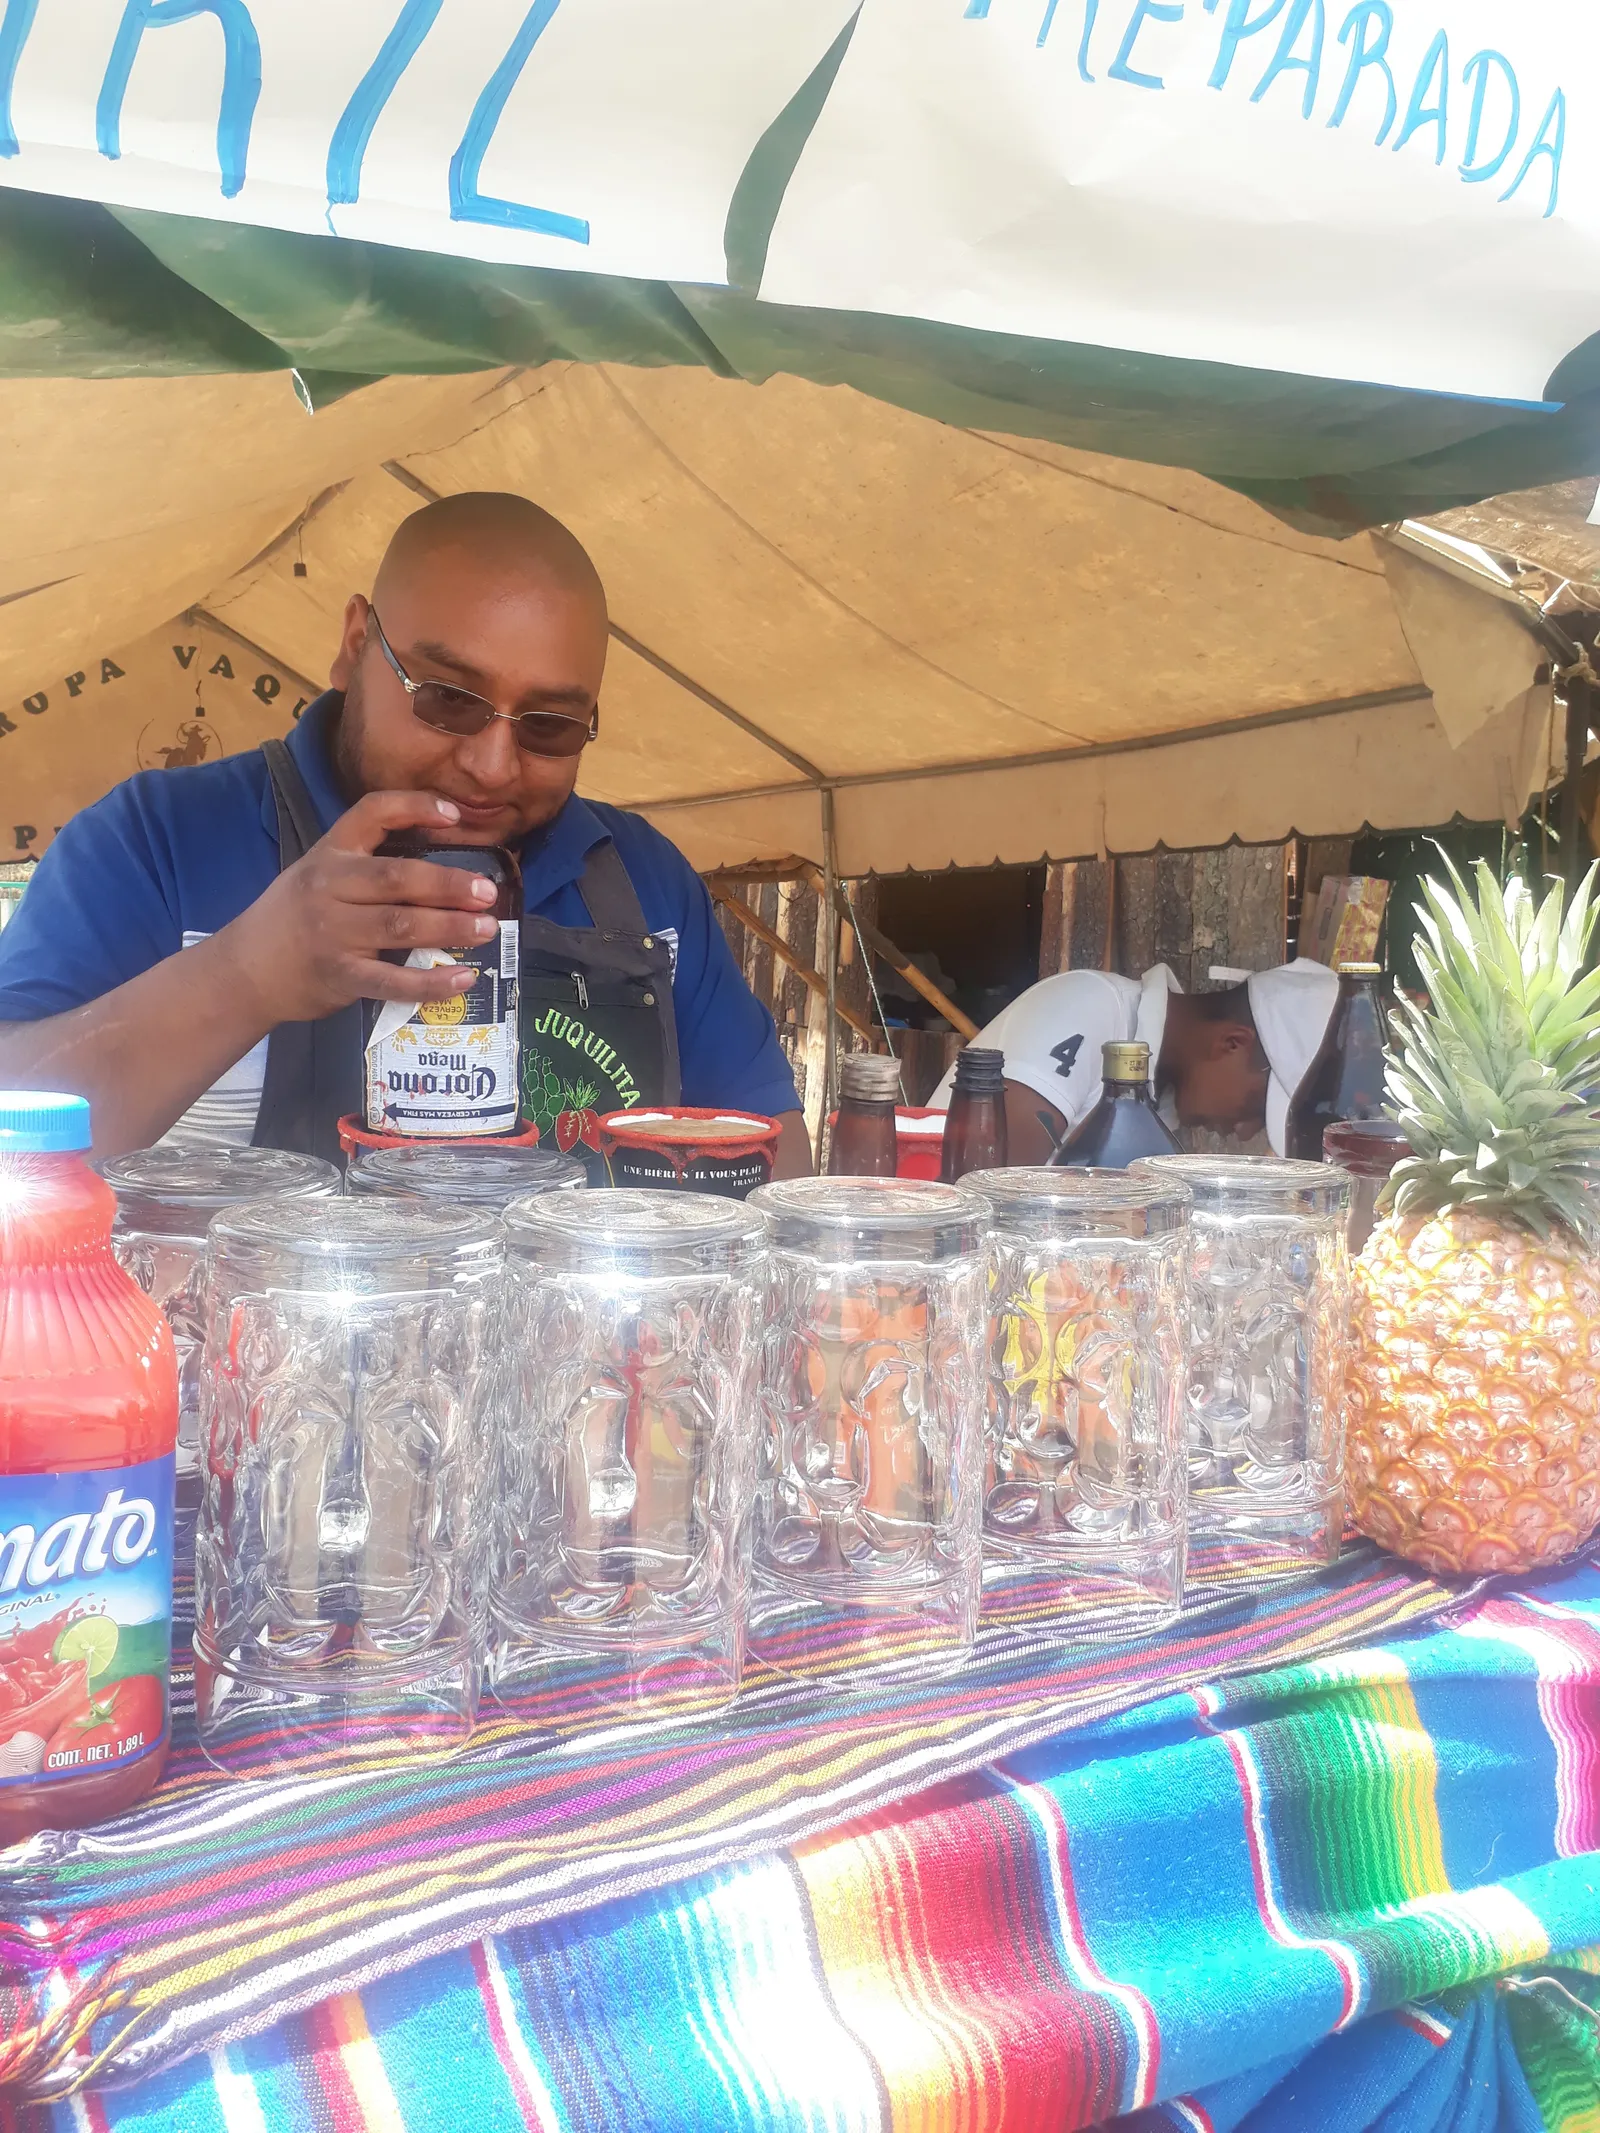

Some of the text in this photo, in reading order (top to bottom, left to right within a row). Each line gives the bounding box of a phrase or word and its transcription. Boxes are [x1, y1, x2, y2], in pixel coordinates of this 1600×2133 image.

[534, 1008, 641, 1110] JUQUILITA
[1049, 1033, 1085, 1078] 4
[387, 1064, 497, 1101] Corona
[437, 1110, 470, 1118] CERVEZA
[623, 1164, 642, 1176] UNE
[709, 1168, 737, 1180] VOUS
